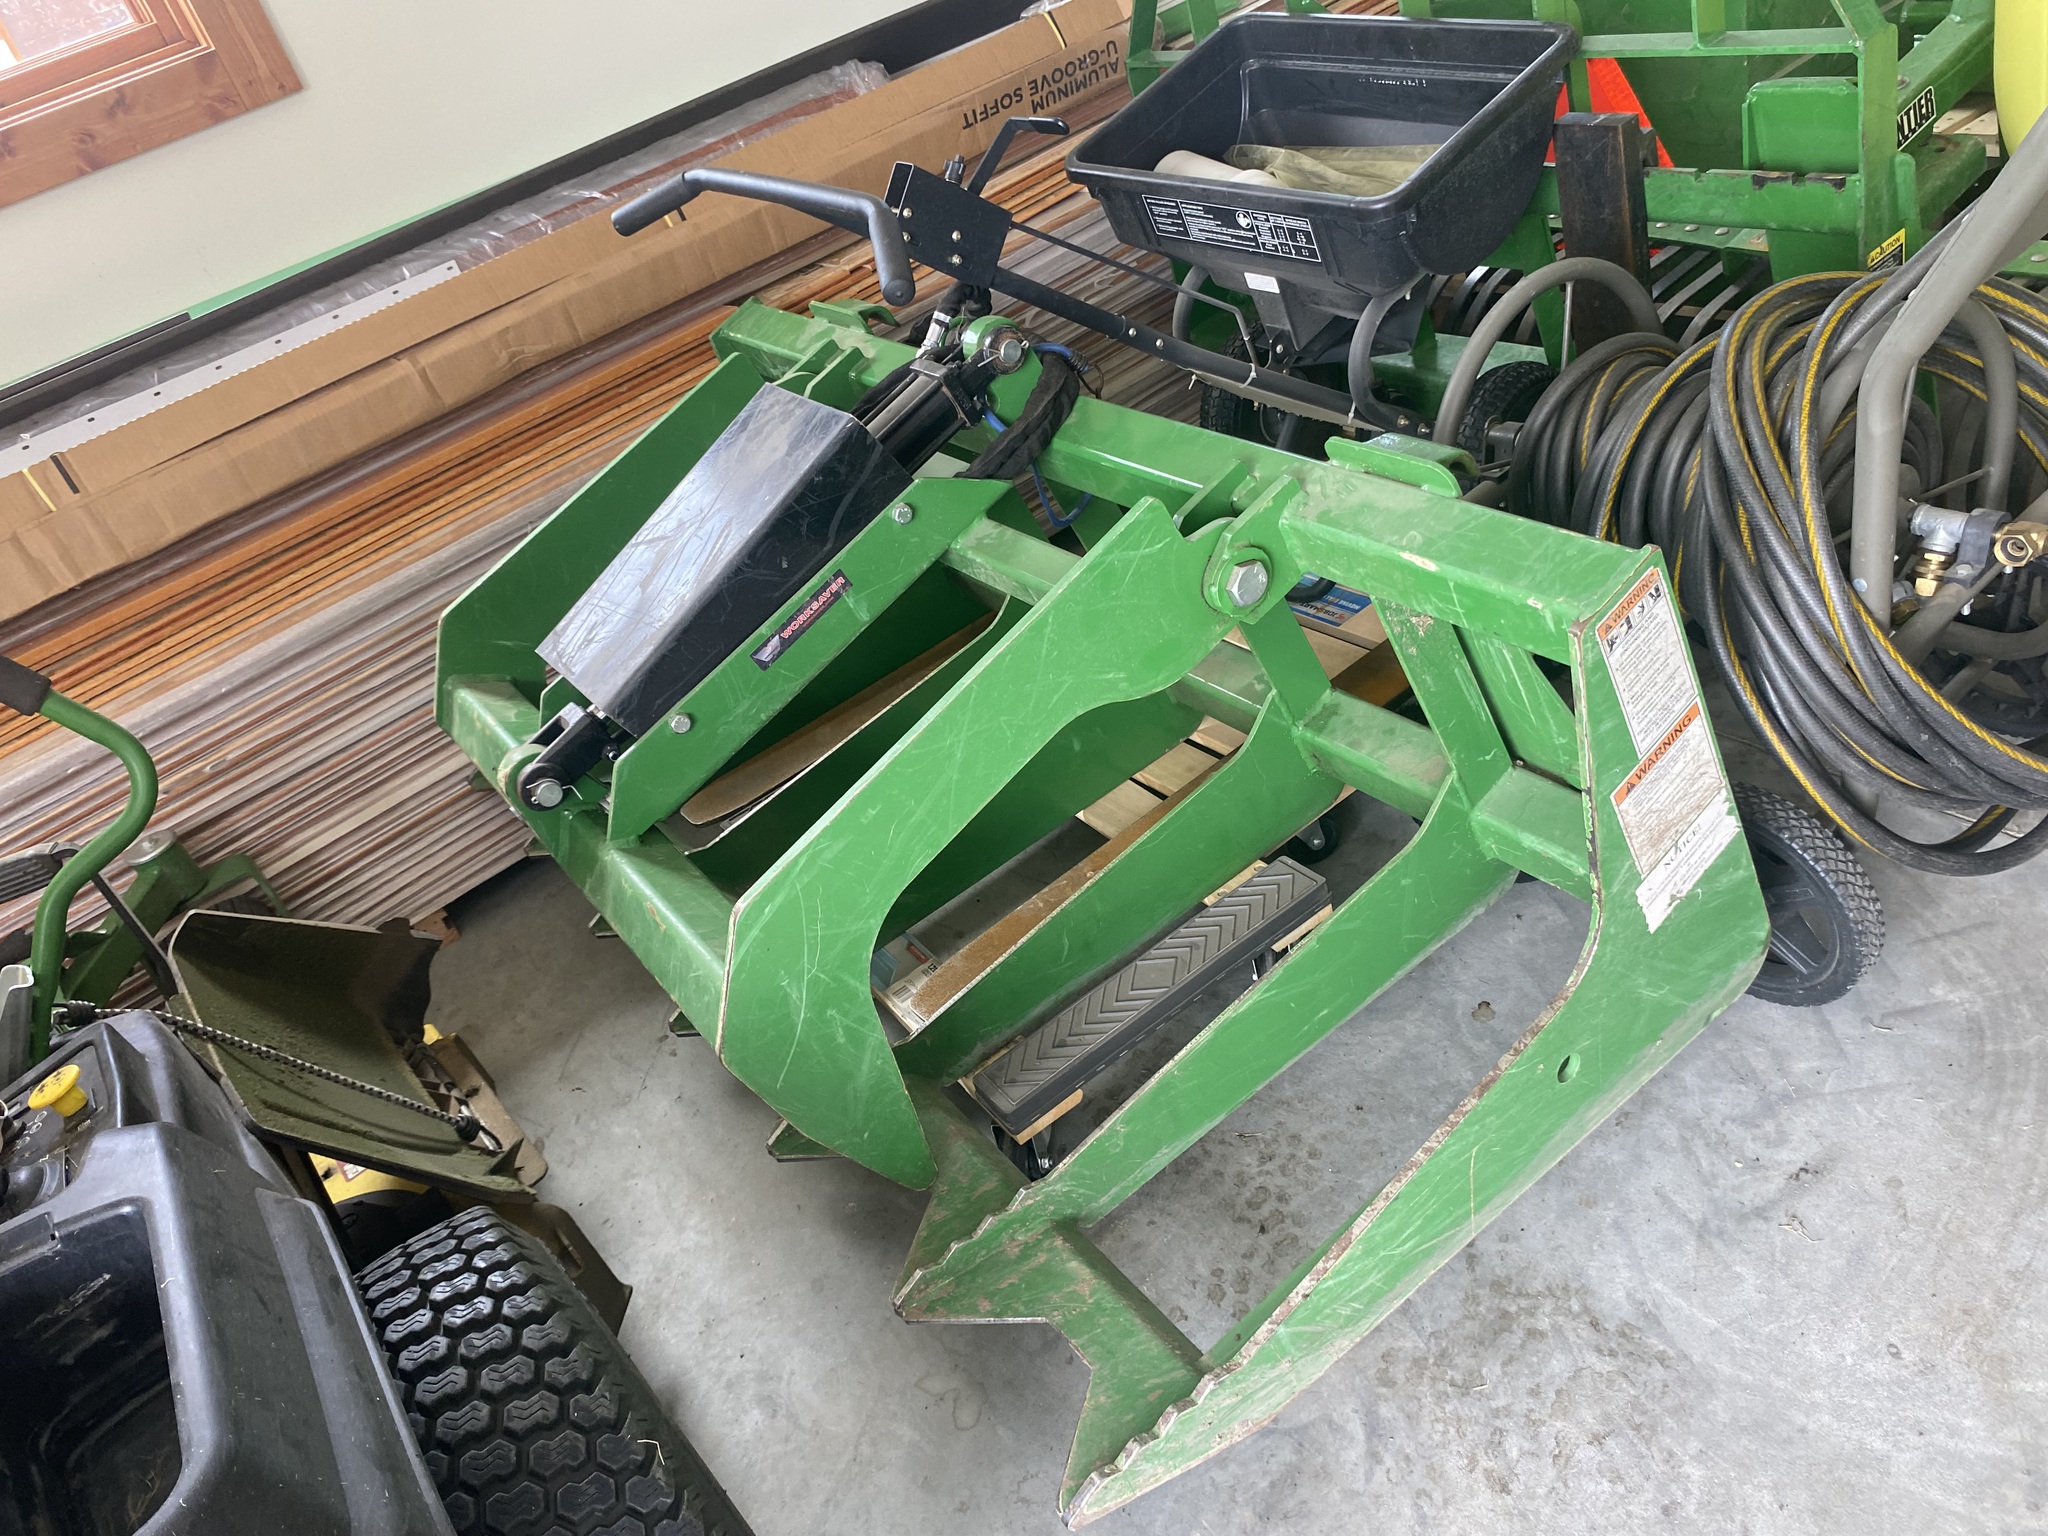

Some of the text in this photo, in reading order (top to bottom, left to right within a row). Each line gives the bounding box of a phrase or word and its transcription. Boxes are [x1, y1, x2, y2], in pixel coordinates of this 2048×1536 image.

[962, 40, 1118, 130] U-GROOVE SOFFIT
[1031, 57, 1119, 114] ALUMINUM
[780, 576, 846, 639] WORKSAVER
[1634, 714, 1693, 781] WARNING
